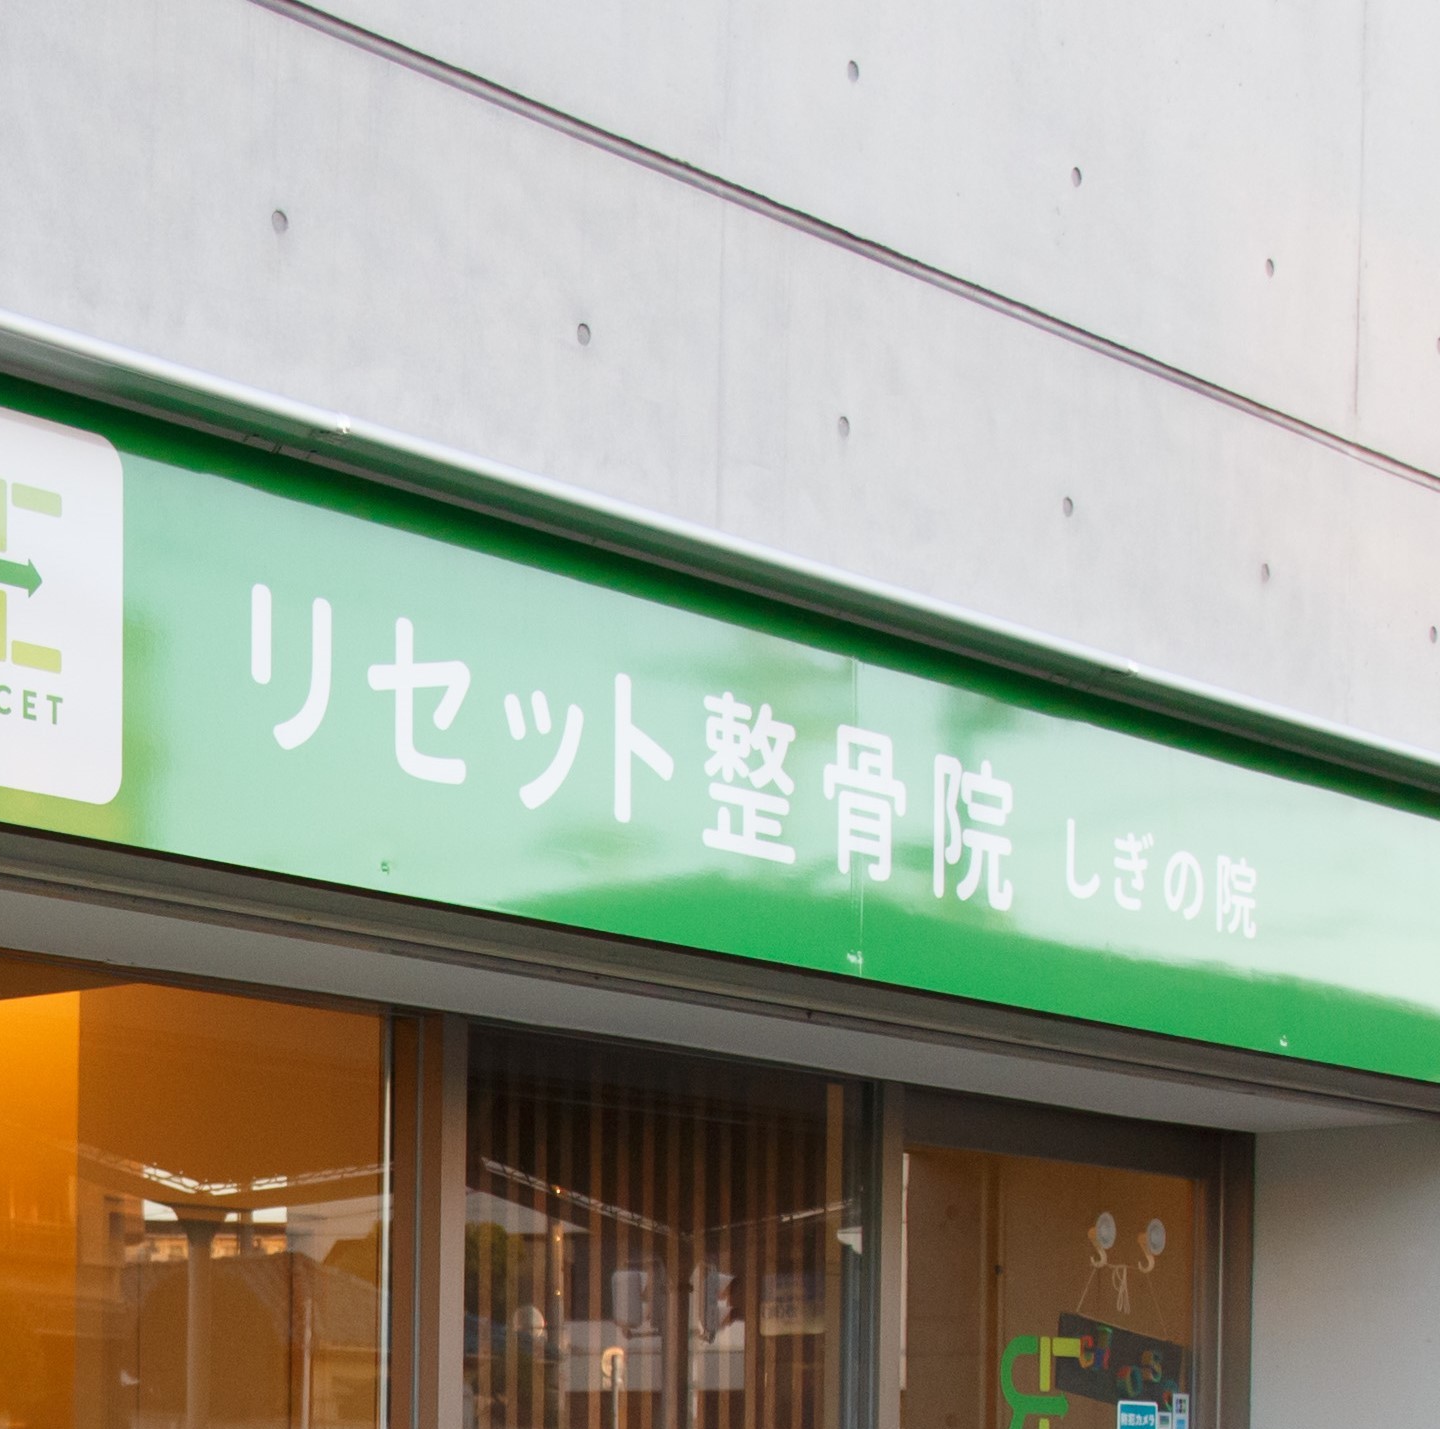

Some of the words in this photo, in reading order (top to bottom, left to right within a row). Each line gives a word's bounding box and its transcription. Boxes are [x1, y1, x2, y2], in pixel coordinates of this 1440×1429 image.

[250, 582, 1014, 912] リセット整骨院
[1066, 817, 1258, 939] しぎの院
